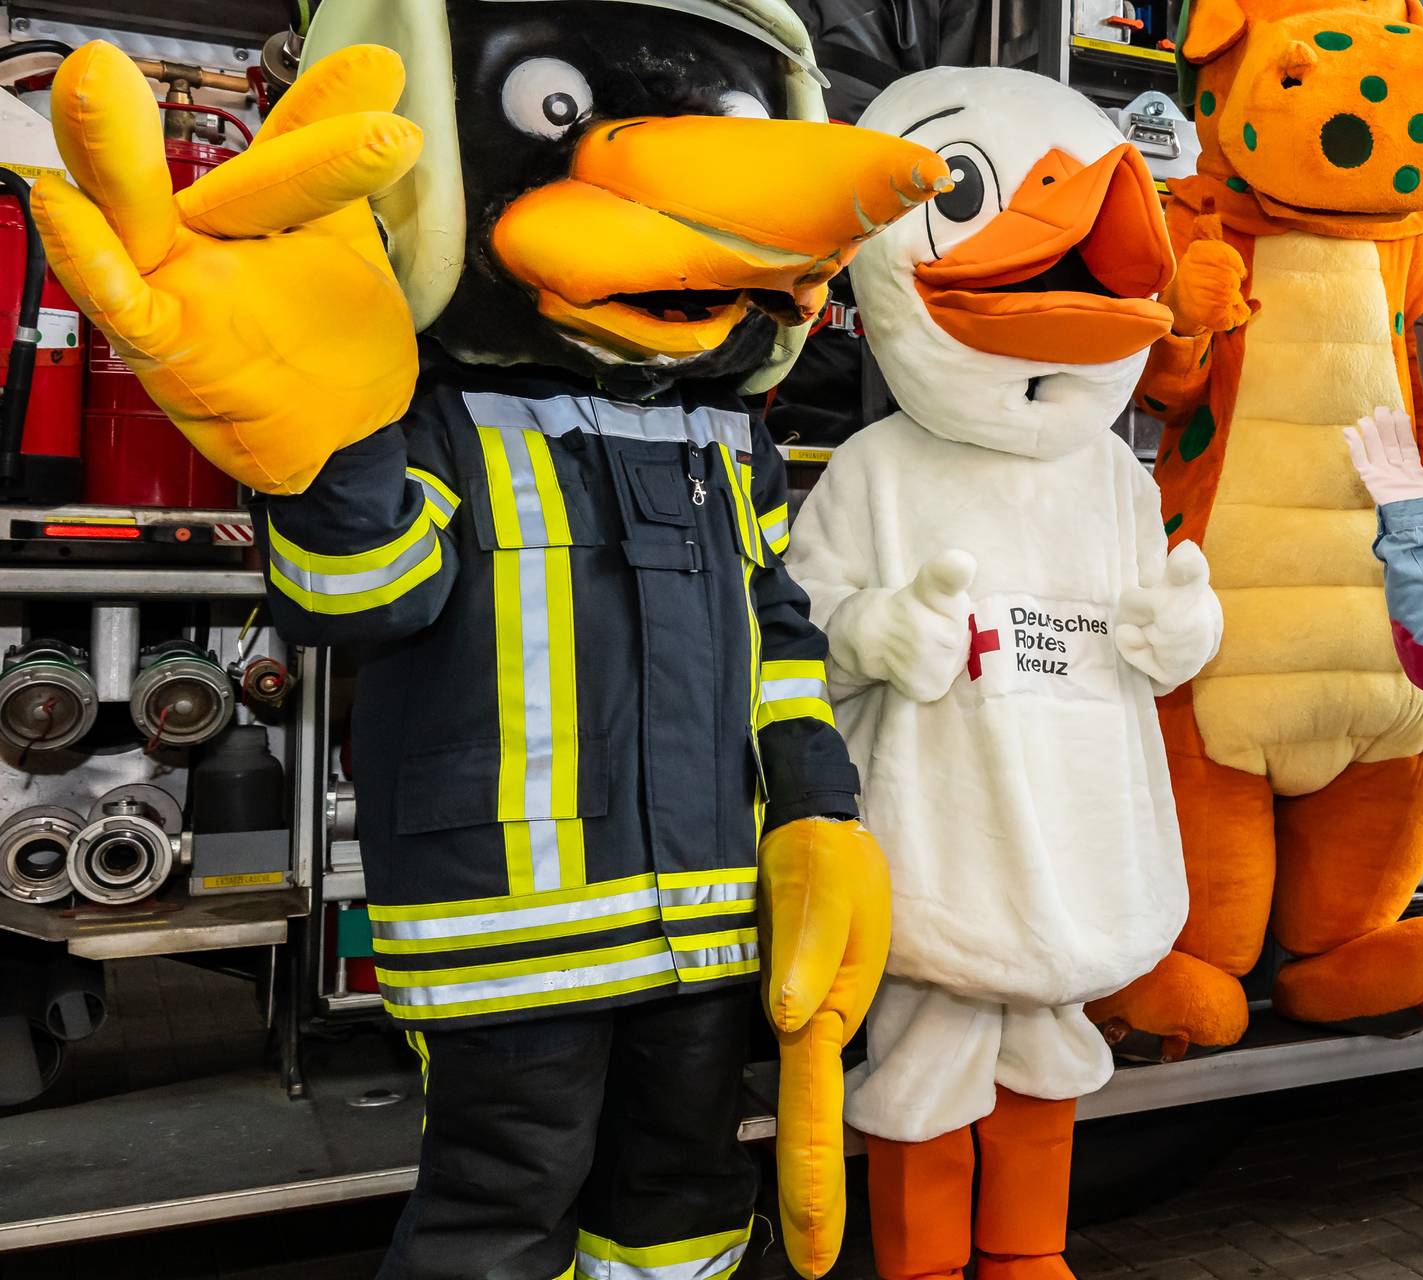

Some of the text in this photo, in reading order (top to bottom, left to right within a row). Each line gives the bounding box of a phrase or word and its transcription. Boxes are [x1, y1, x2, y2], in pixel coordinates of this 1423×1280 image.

[1009, 607, 1108, 635] Deutsches
[1014, 629, 1067, 653] Rotes
[1016, 652, 1068, 676] Kreuz
